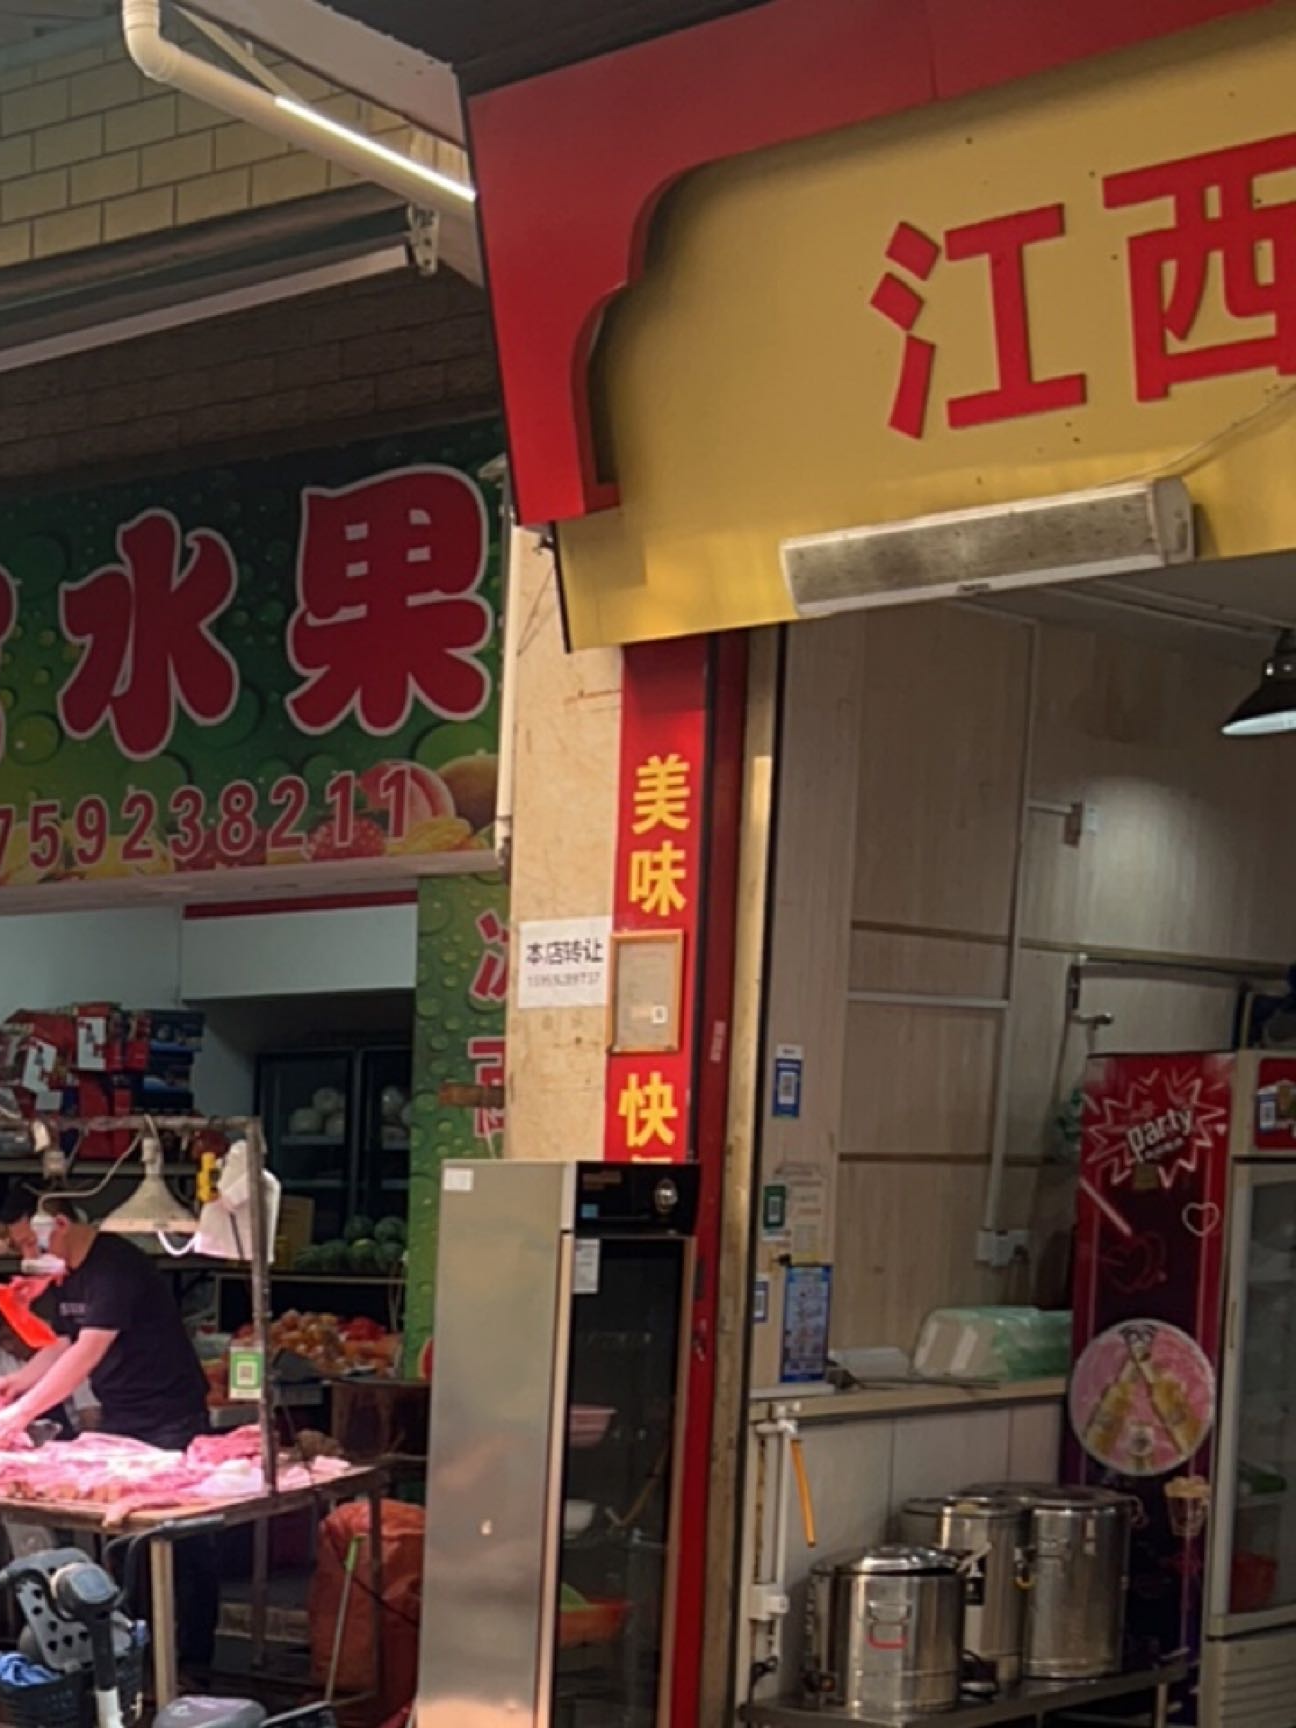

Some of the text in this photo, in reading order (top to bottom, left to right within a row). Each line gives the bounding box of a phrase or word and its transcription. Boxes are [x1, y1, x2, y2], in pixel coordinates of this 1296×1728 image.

[870, 131, 1296, 440] 江西
[629, 755, 691, 917] 美味
[618, 1071, 679, 1162] 快
